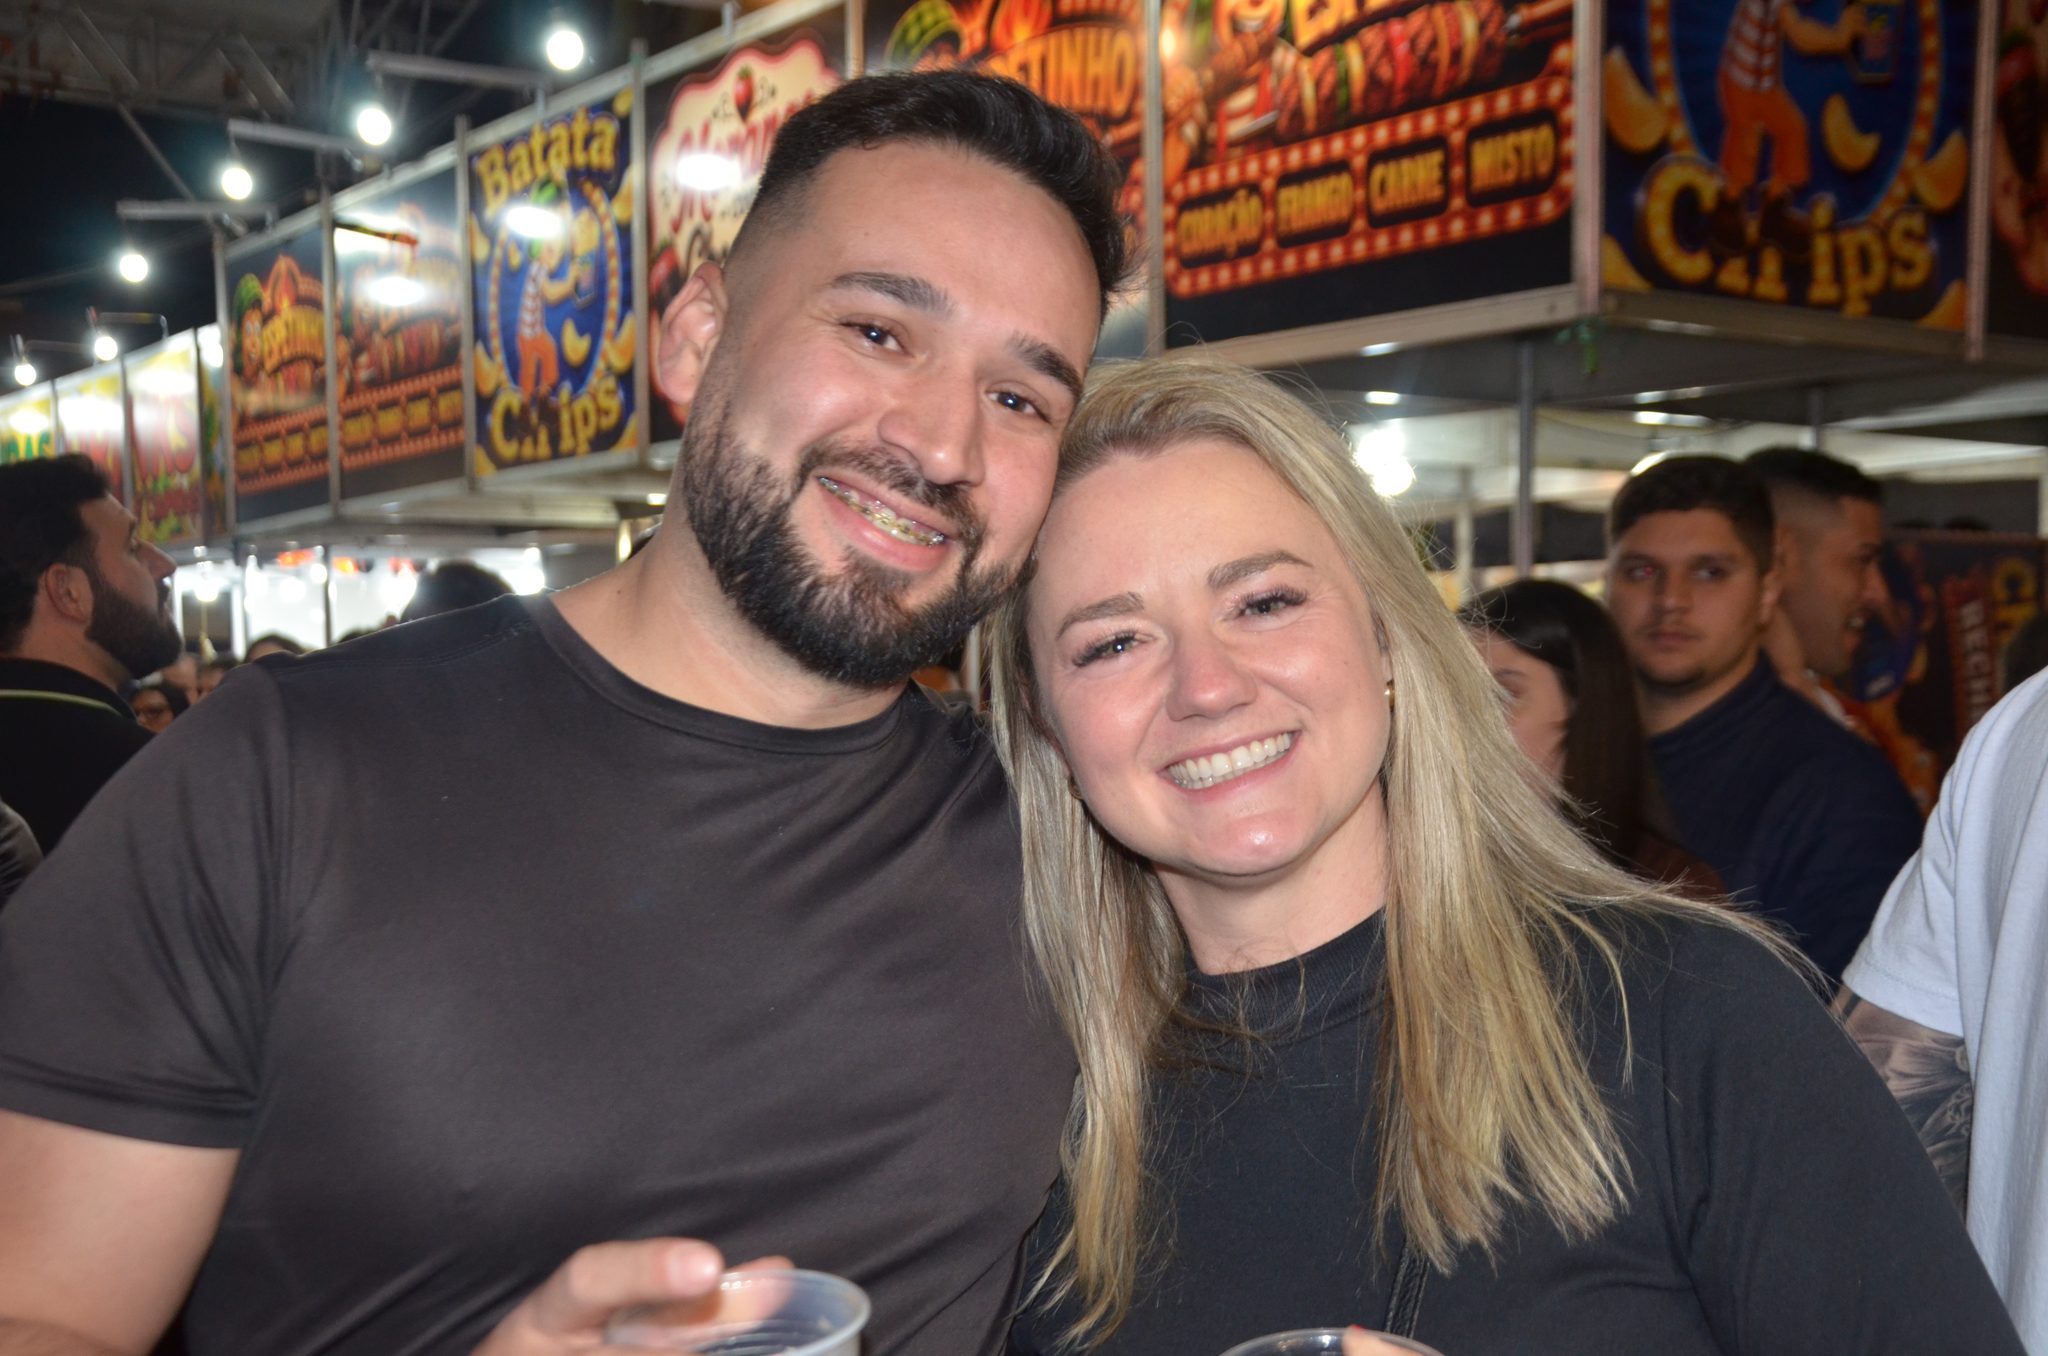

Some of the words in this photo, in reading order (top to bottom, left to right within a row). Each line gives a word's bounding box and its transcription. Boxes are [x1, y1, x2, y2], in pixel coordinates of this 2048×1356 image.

[478, 108, 617, 212] Batata
[1276, 171, 1353, 240] FRANGO
[1369, 148, 1445, 217] CARNE
[1469, 121, 1556, 195] MISTO
